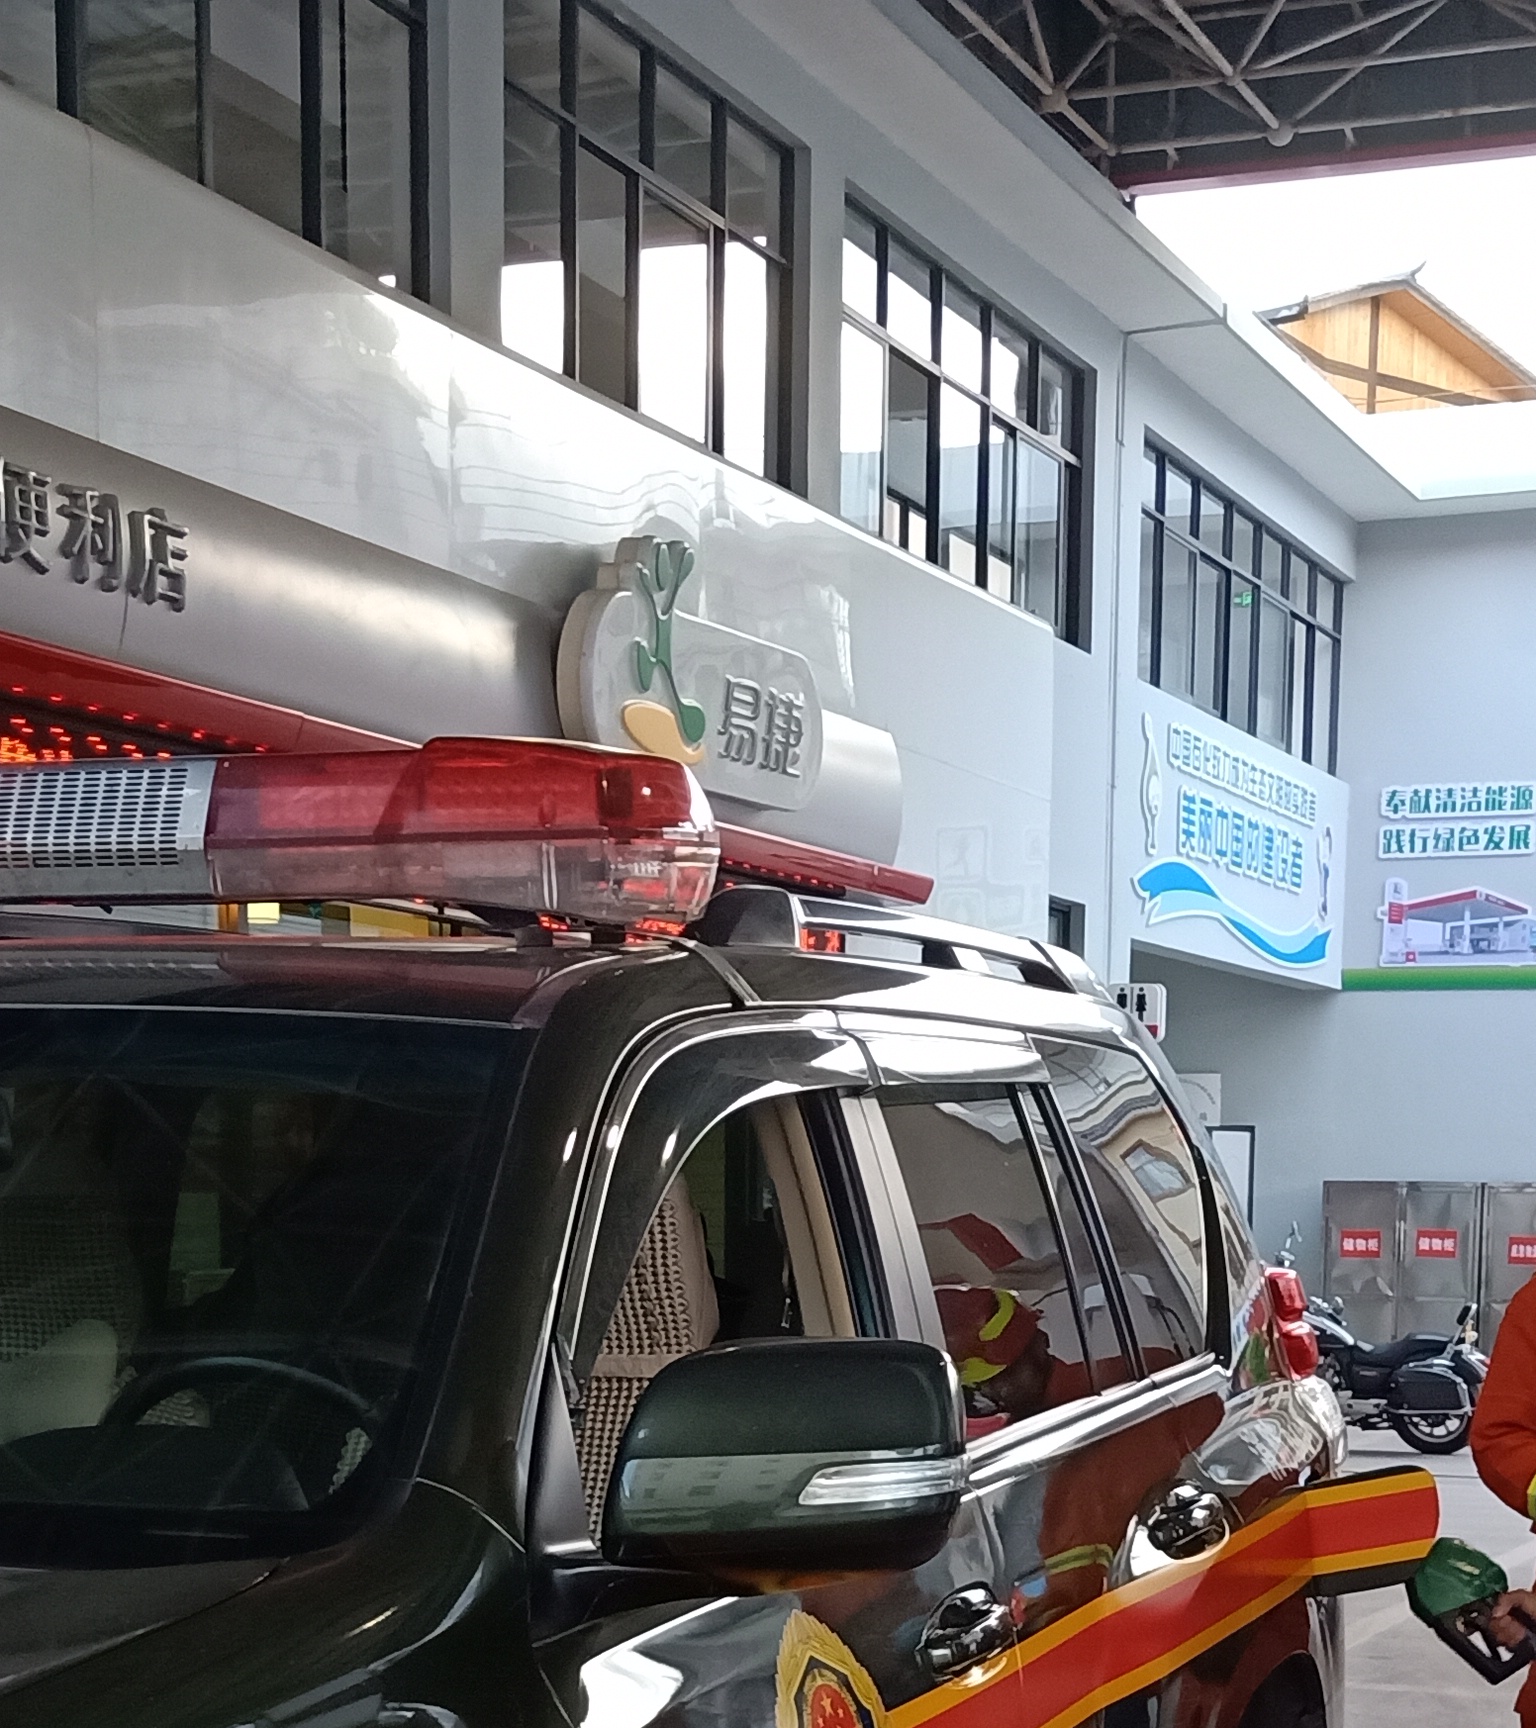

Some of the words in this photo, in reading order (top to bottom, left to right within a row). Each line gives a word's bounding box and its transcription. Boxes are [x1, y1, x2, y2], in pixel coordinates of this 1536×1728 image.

[716, 673, 806, 779] 易捷
[1384, 785, 1534, 815] 奉献清洁能源
[1181, 790, 1304, 890] 美丽中国的建设者
[1382, 824, 1531, 855] 践行绿色发展
